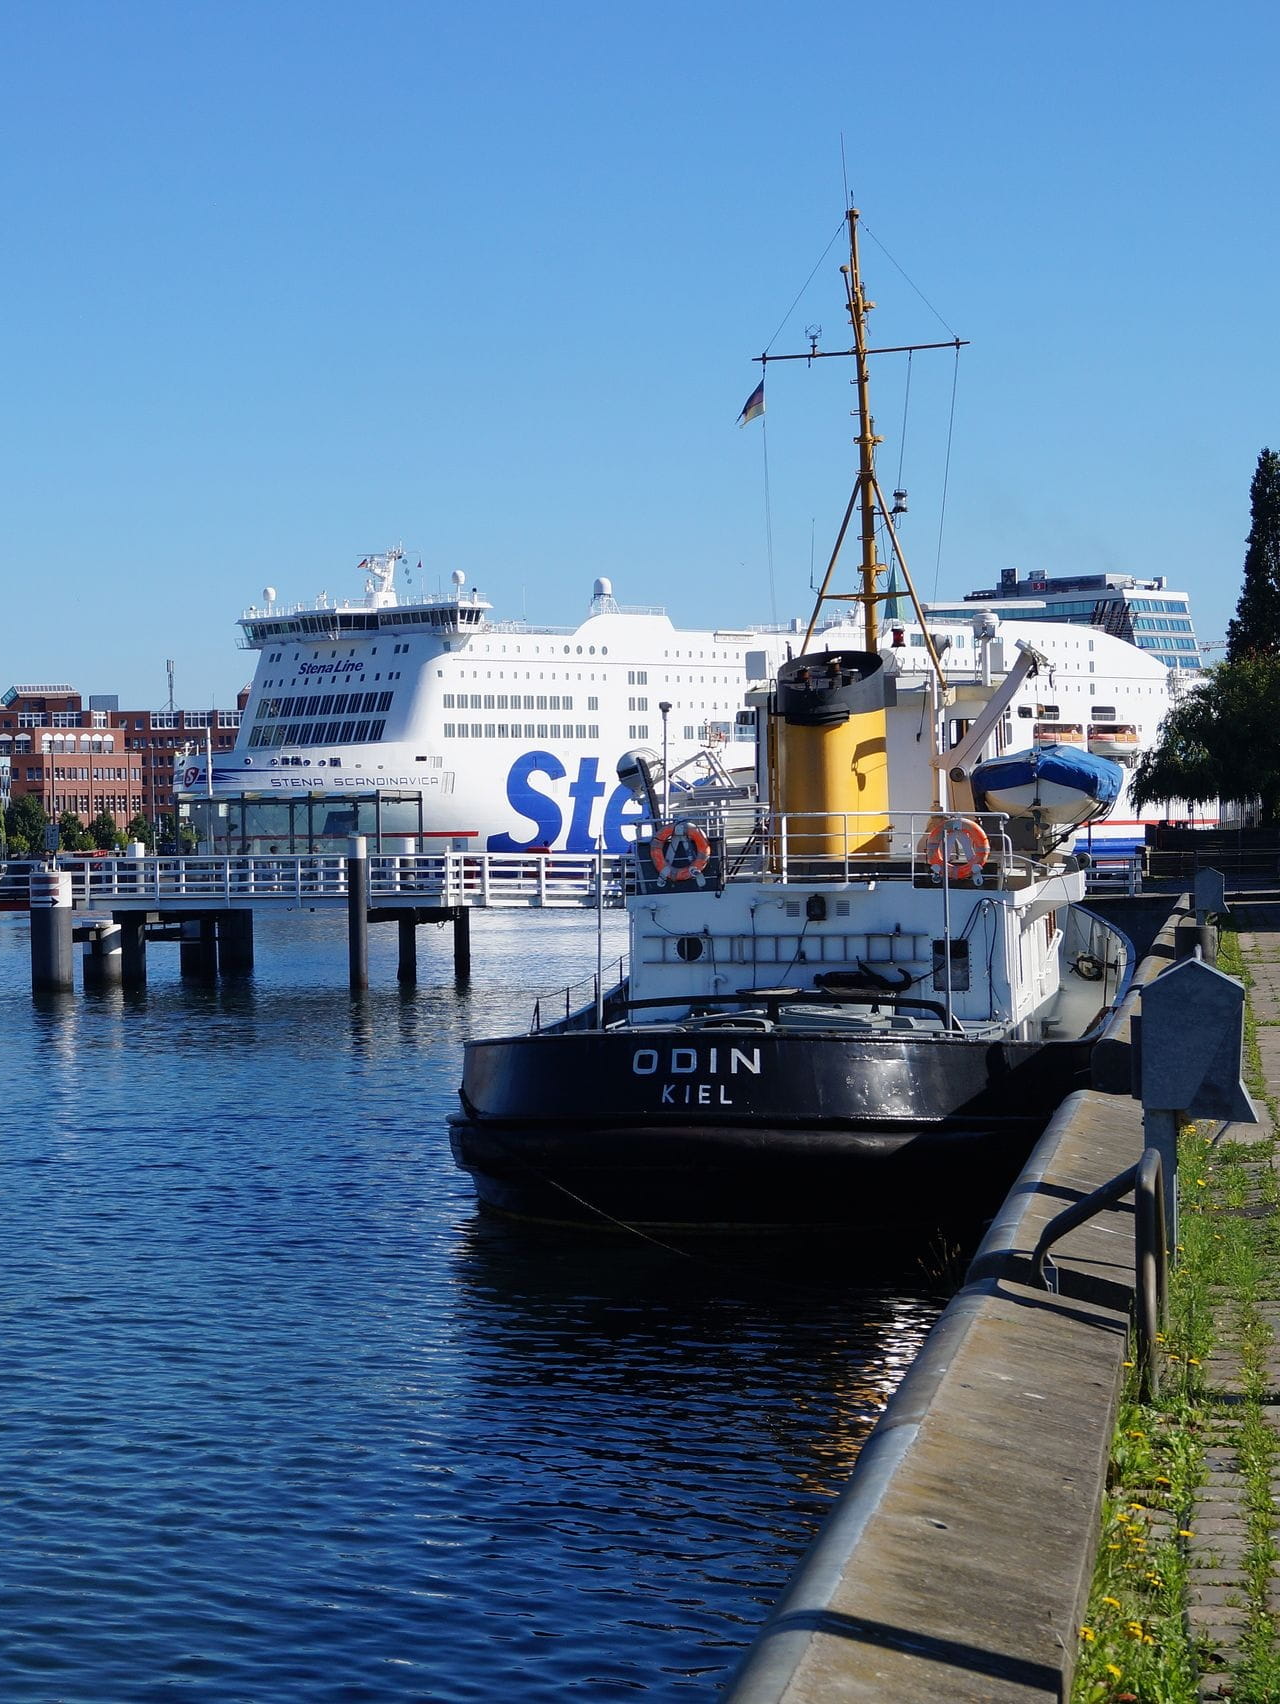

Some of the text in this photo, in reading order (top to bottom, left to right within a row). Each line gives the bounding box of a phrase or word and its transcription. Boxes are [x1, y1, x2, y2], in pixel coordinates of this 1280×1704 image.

[270, 776, 439, 787] STENA SCANDINAVICA
[632, 1047, 761, 1075] ODIN
[661, 1084, 733, 1105] KIEL
